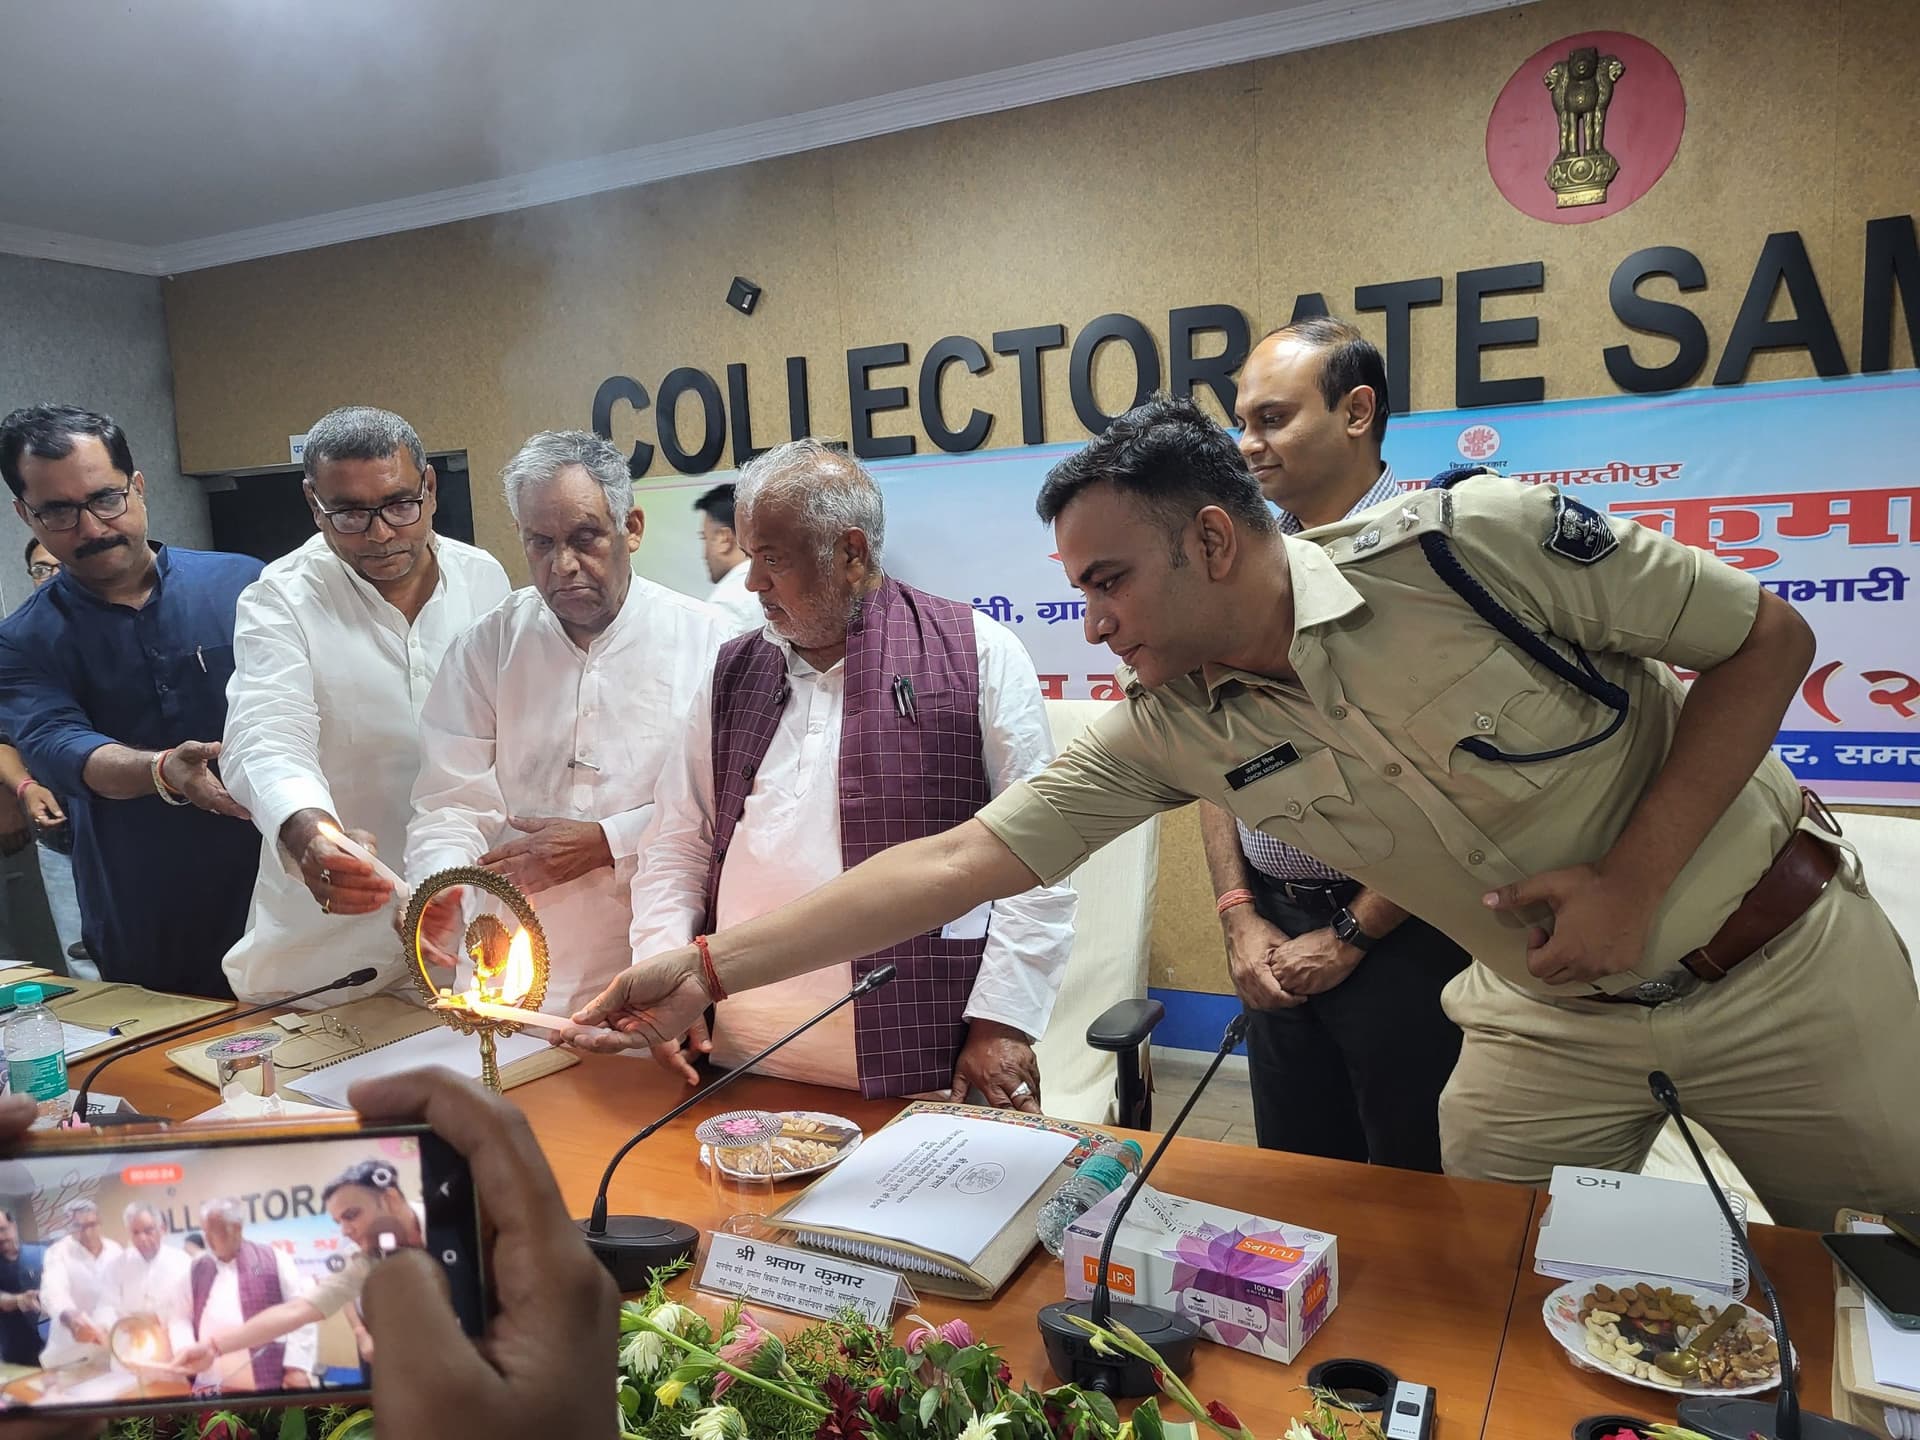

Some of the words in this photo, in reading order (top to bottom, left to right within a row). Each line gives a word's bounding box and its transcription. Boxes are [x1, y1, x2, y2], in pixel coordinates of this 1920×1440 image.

[1243, 1240, 1297, 1260] TULIPS
[736, 1245, 755, 1262] श्री
[764, 1254, 805, 1275] श्रवण
[815, 1267, 865, 1289] कुमार
[1086, 1263, 1132, 1288] TIPS
[1253, 1283, 1267, 1293] 100
